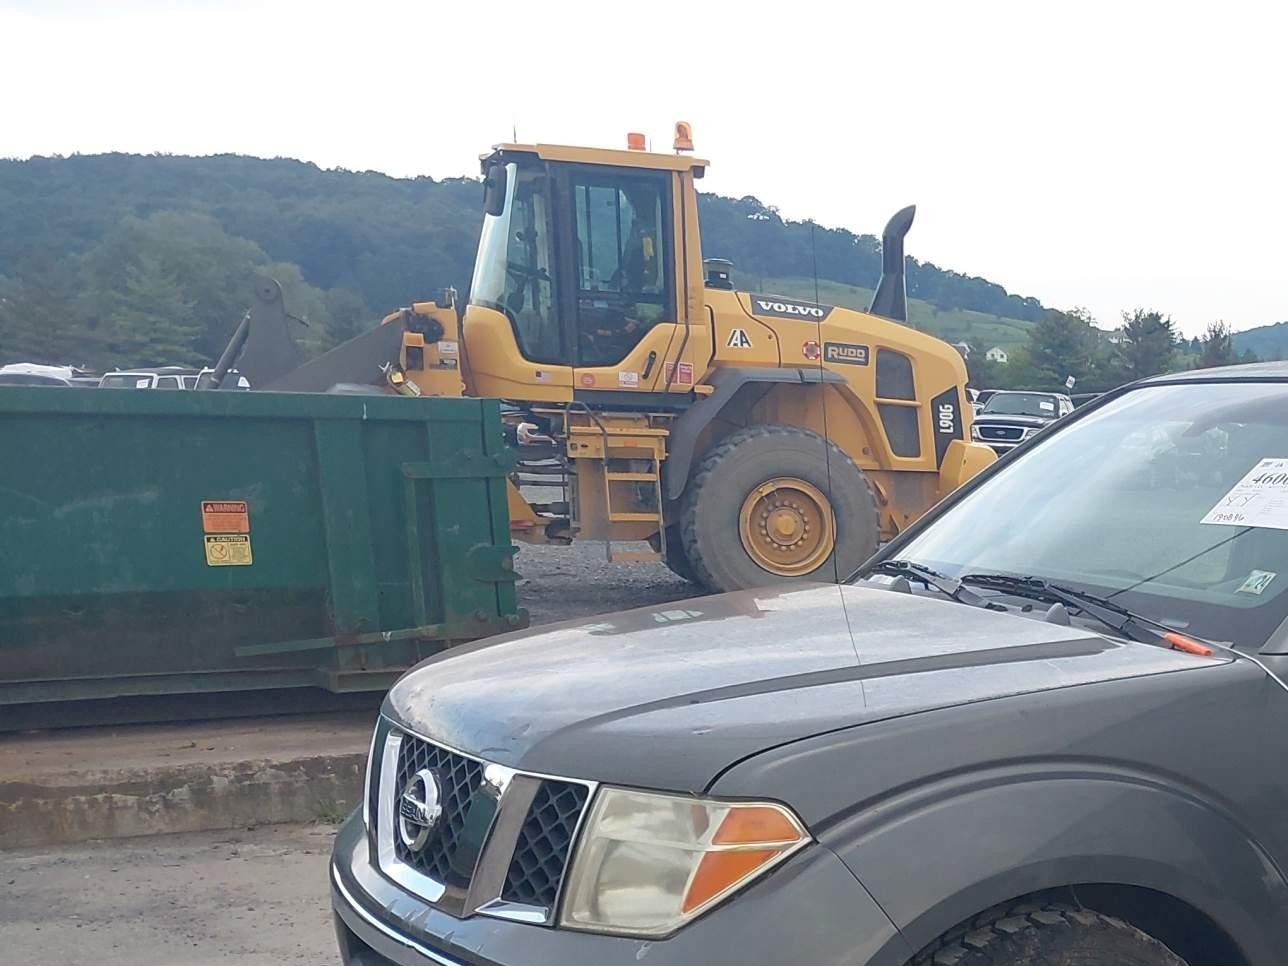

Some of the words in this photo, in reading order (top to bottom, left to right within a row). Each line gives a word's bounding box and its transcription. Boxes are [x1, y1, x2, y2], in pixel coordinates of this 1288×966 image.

[757, 301, 824, 317] VOLVO
[827, 346, 866, 359] RUDD
[939, 404, 954, 433] L90G
[213, 504, 245, 513] WARNING
